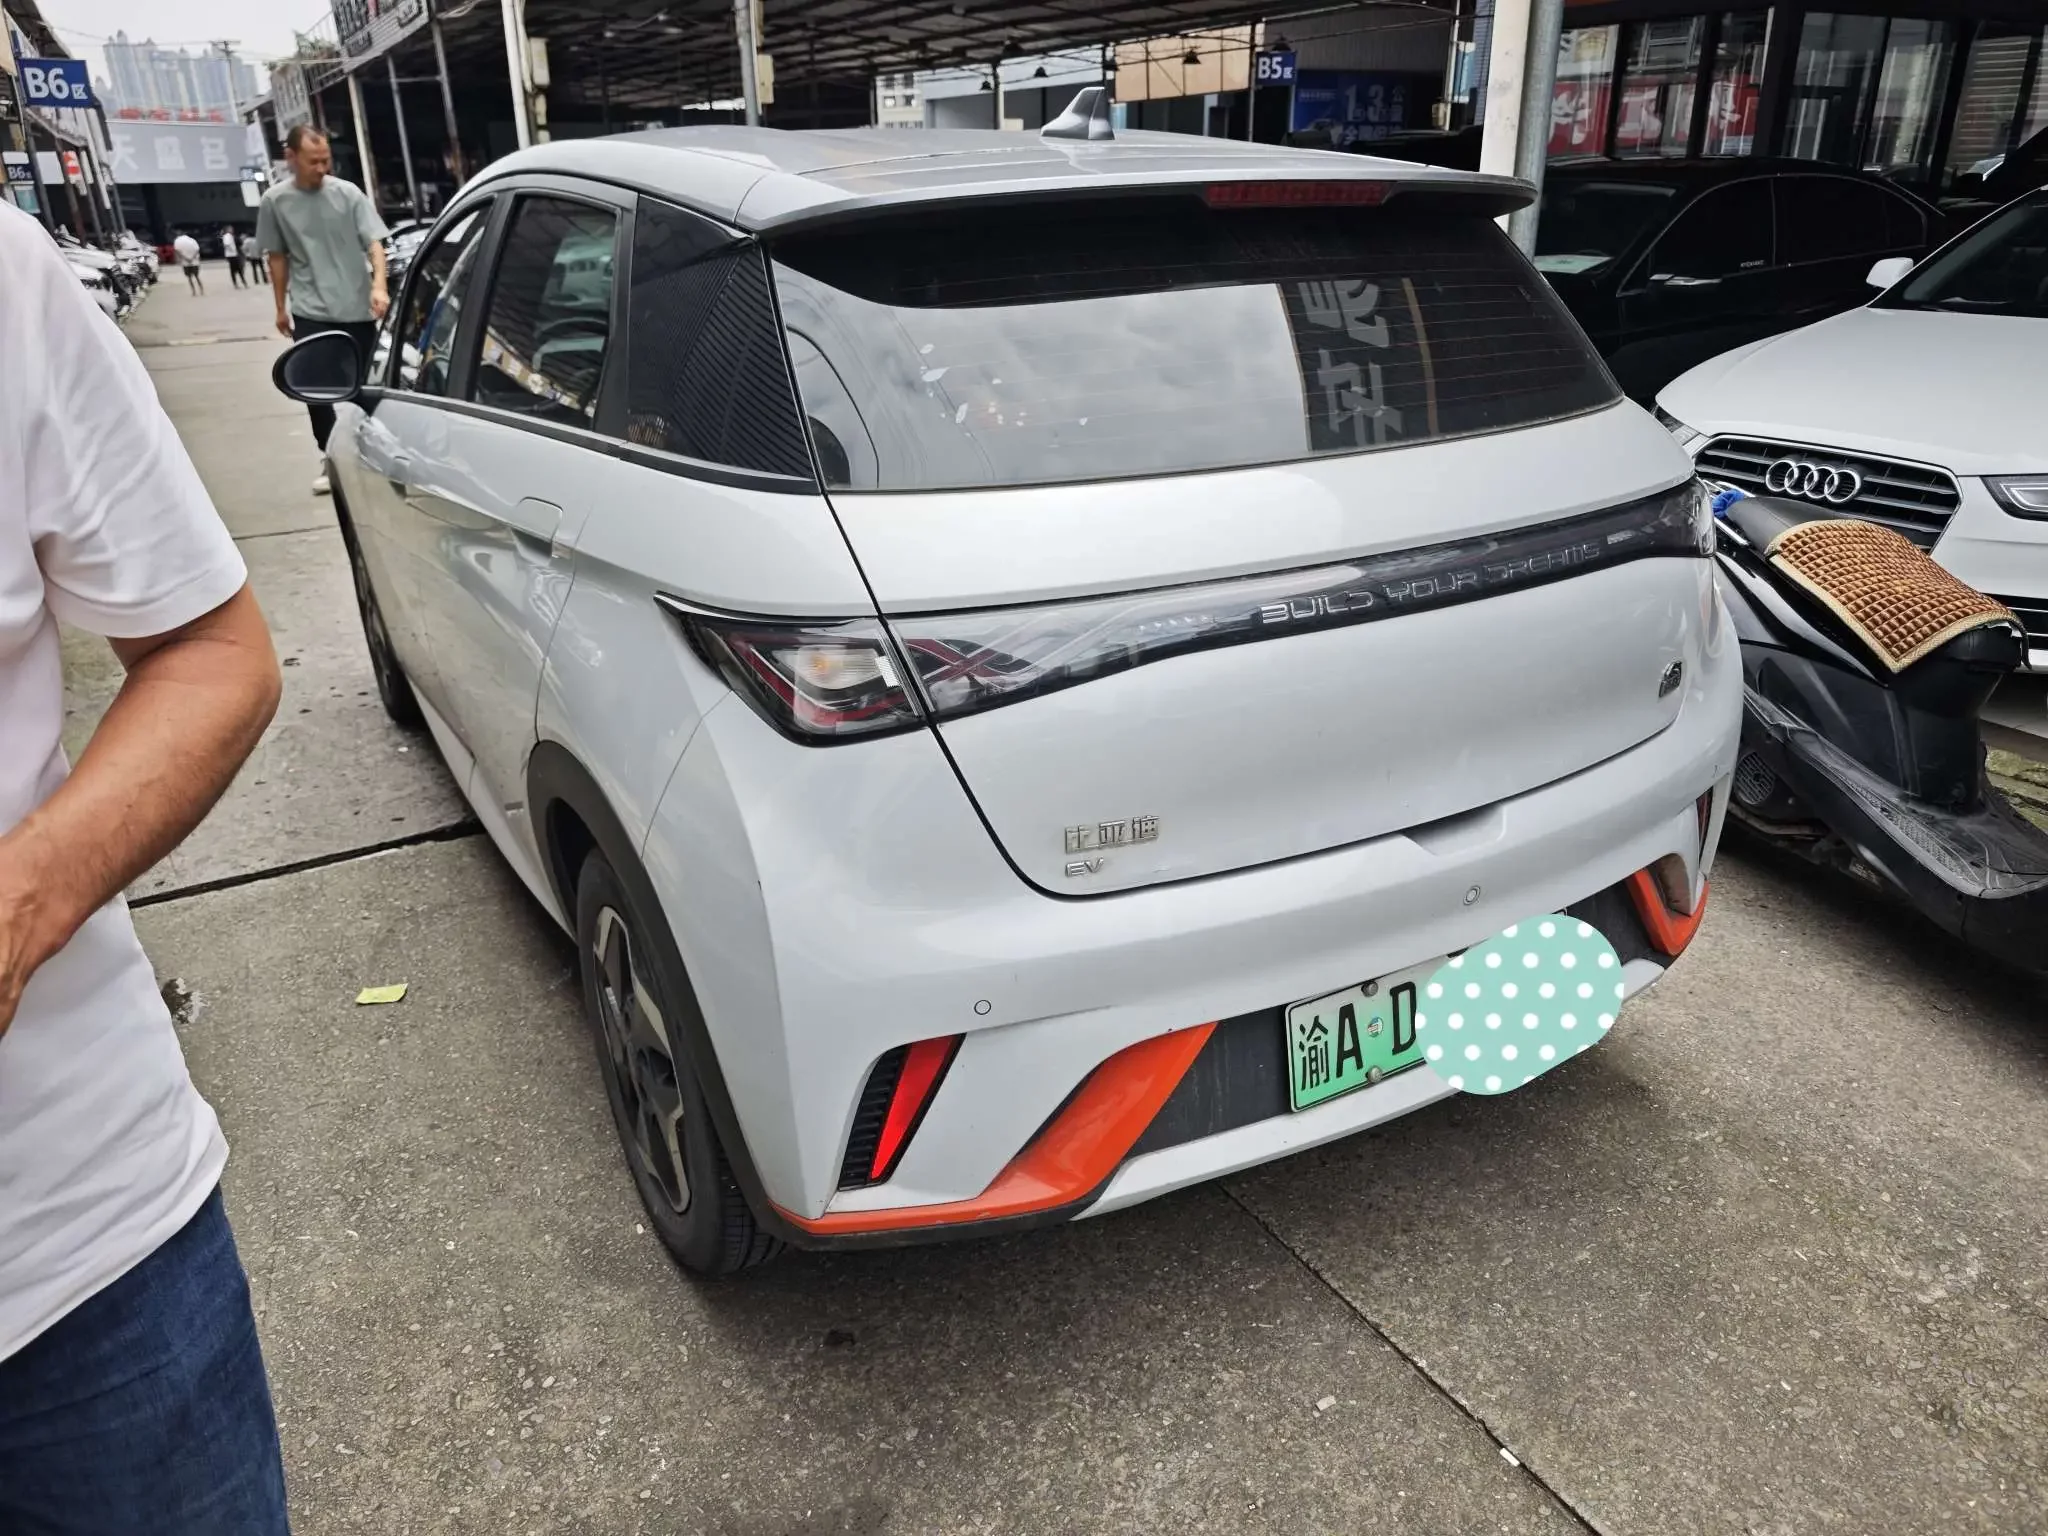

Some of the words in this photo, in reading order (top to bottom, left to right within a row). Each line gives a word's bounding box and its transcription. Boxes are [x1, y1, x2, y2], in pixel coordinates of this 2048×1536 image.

[1260, 591, 1374, 625] BUILD
[1382, 570, 1479, 601] YOUR
[1486, 542, 1601, 584] DREAMS
[1065, 815, 1159, 854] 比亚迪
[1065, 857, 1104, 878] EV
